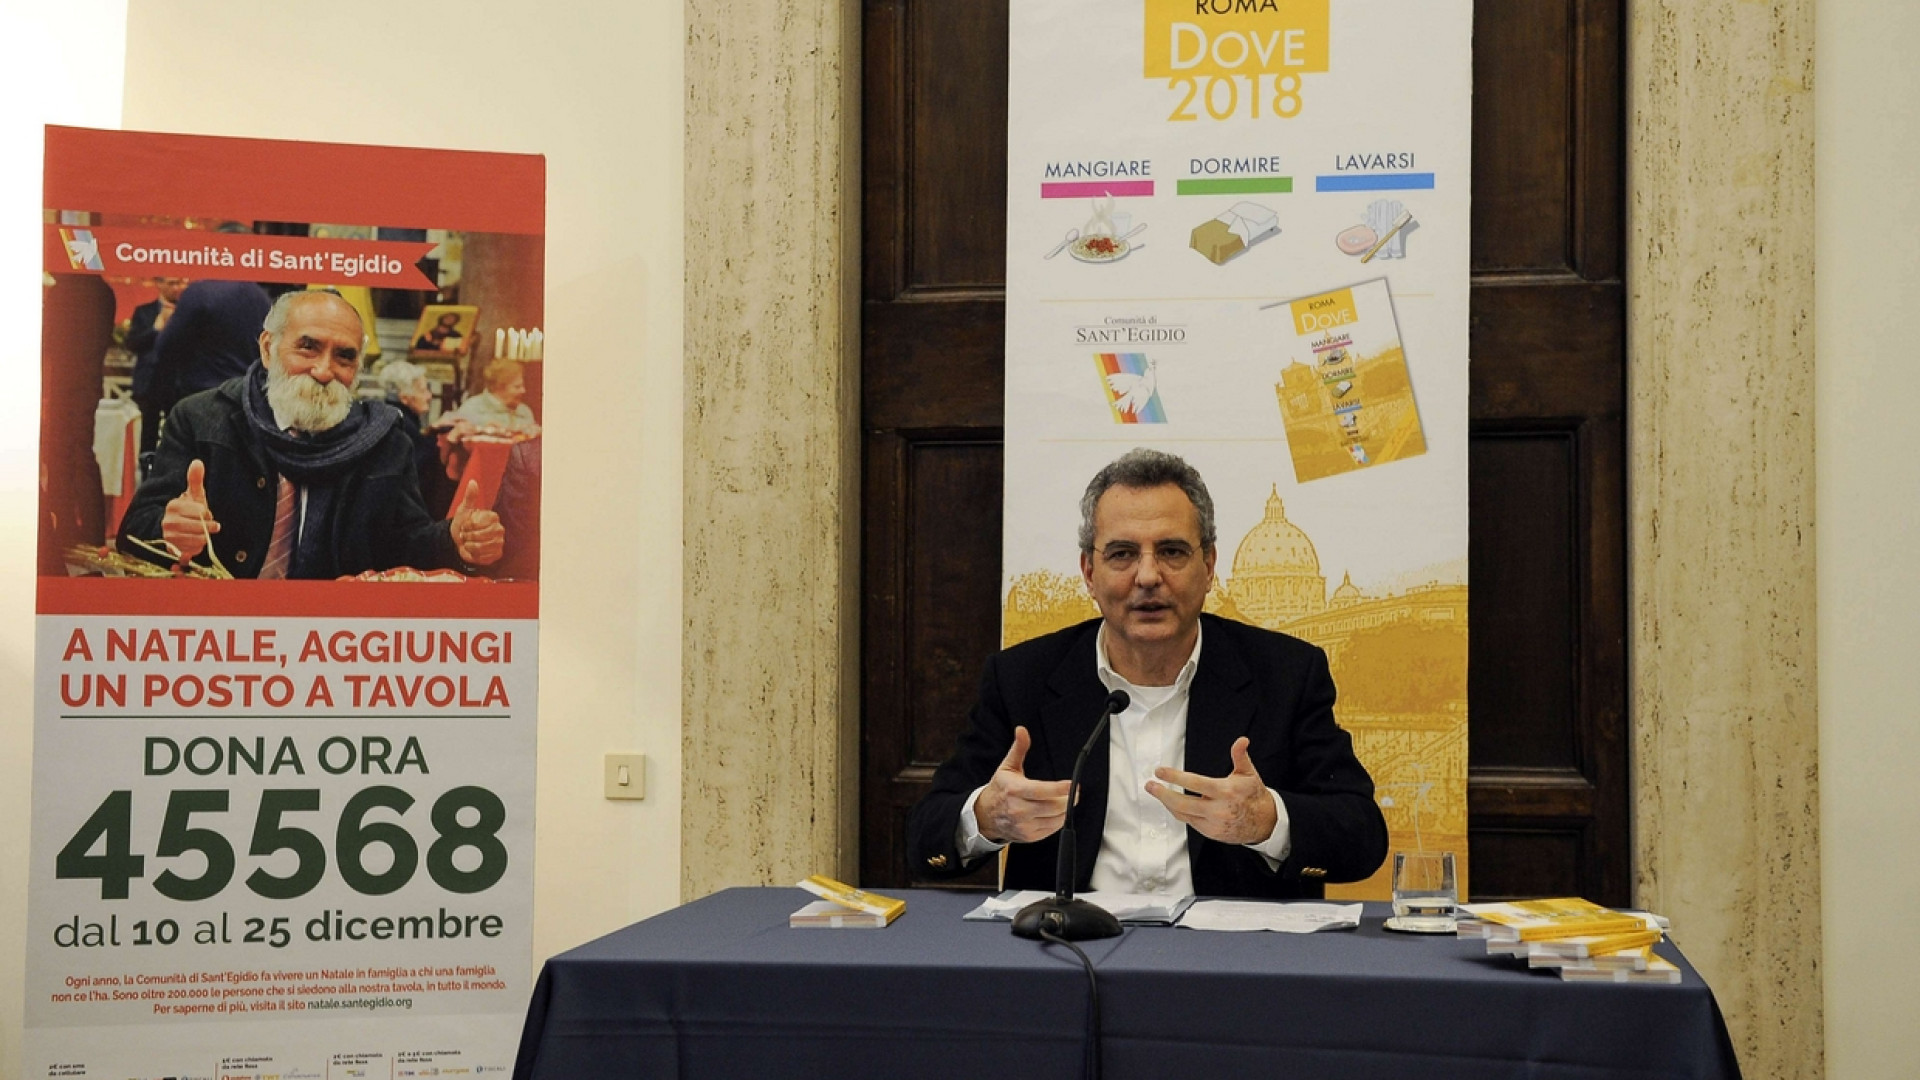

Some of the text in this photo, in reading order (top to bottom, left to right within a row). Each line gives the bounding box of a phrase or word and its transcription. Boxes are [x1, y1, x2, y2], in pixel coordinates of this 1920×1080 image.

[1196, 0, 1278, 15] ROMA
[1170, 22, 1305, 70] DOVE
[1167, 72, 1302, 121] 2018
[1045, 161, 1151, 178] MANGIARE
[1190, 157, 1280, 174] DORMIRE
[1335, 153, 1415, 170] LAVARSI
[116, 243, 402, 275] Comunità di Sant'Egidio
[1309, 298, 1335, 310] ROMA
[1104, 315, 1157, 324] Comunità di
[1301, 309, 1352, 332] DOVE
[62, 628, 512, 668] A NATALE, AGGIUNGI
[60, 674, 510, 708] UN POSTO A TAVOLA
[144, 736, 430, 776] DONA ORA
[55, 785, 508, 901] 45568
[53, 908, 503, 948] dal 10 al 25 dicembre
[65, 964, 496, 989] Ogni anno, la Comunità di Sant'Egidio fa vivere un Natale in famiglia a chi una famiglia
[51, 979, 506, 1002] non ce l'ha. Sono oltre 200.000 le persone che si siedono alla nostra tavola, in tutto il mondo.
[154, 1004, 170, 1014] Per
[173, 1004, 215, 1015] saperne
[217, 1001, 226, 1012] di
[250, 1001, 276, 1010] visita
[278, 1000, 286, 1010] il
[288, 1000, 306, 1010] sito
[308, 997, 412, 1010] natale.santegidio.org
